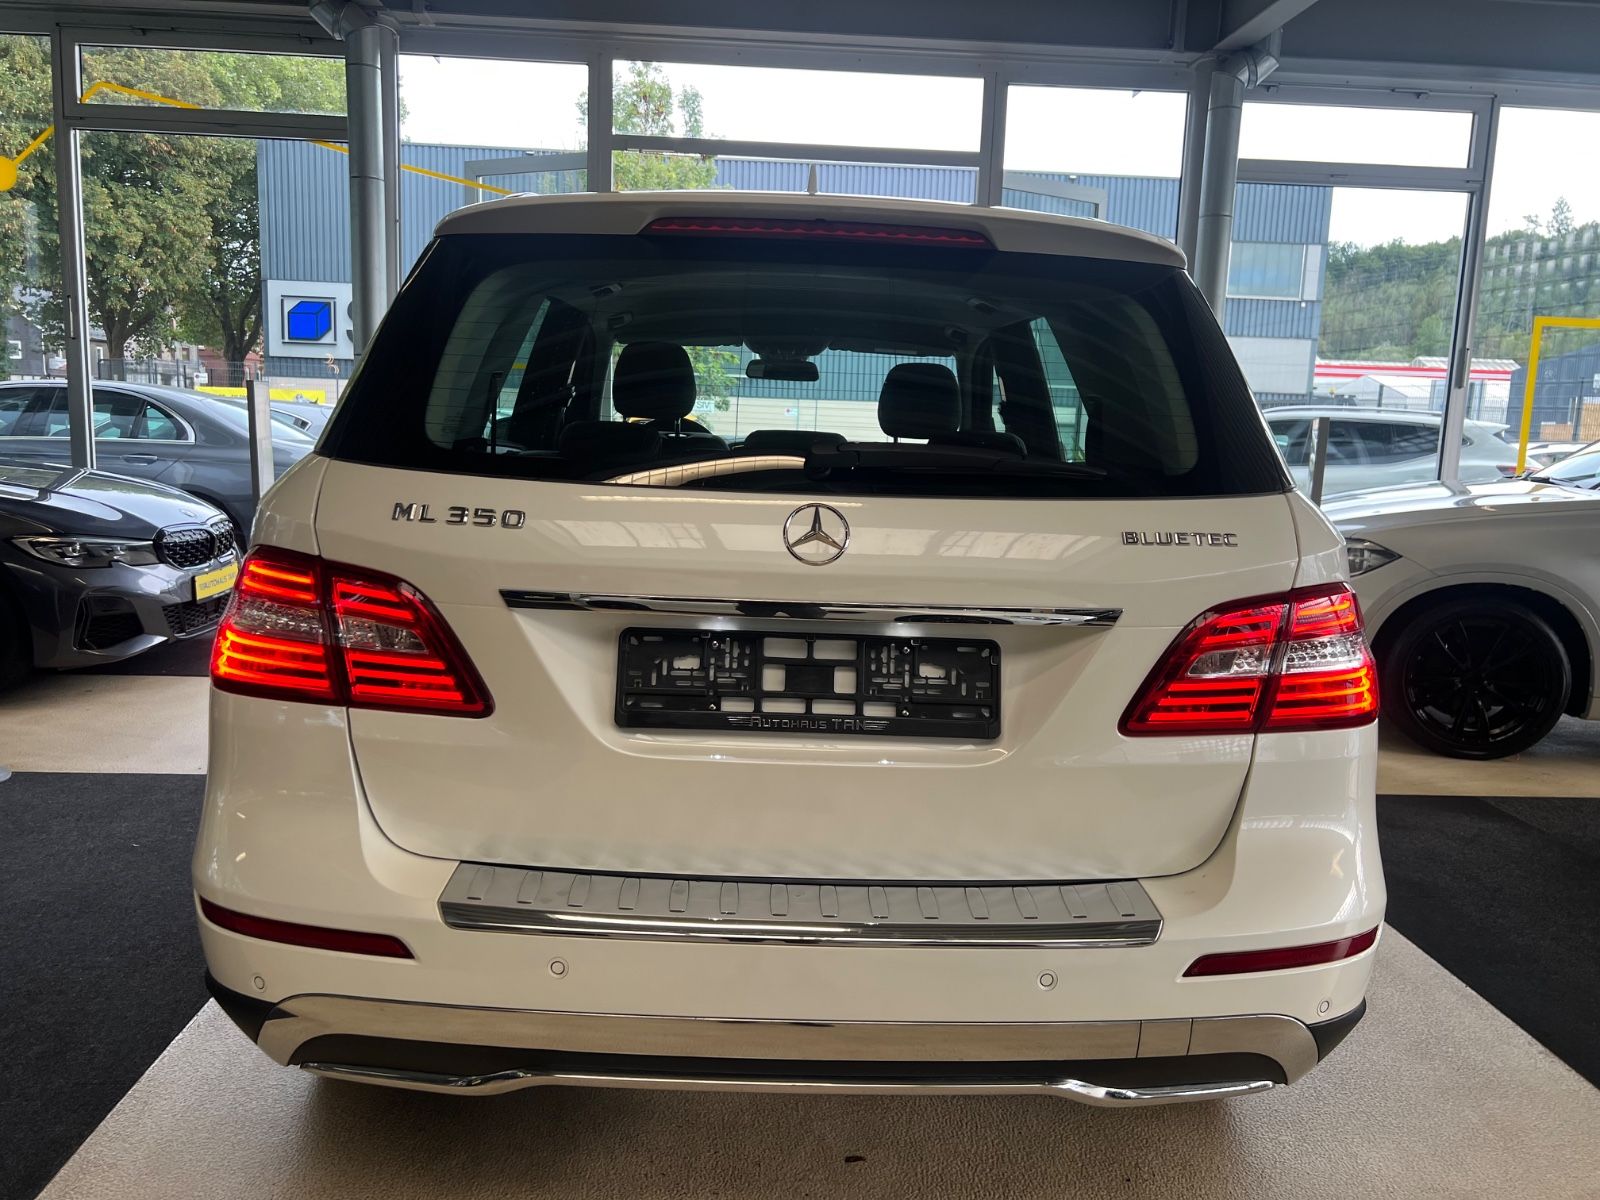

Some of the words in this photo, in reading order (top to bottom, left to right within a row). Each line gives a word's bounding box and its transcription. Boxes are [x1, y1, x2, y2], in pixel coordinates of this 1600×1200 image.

[391, 502, 437, 523] ML
[445, 506, 526, 529] 350
[1121, 531, 1239, 547] BLUETEC
[750, 716, 828, 729] AUTOHAUS
[832, 718, 867, 731] TAN
